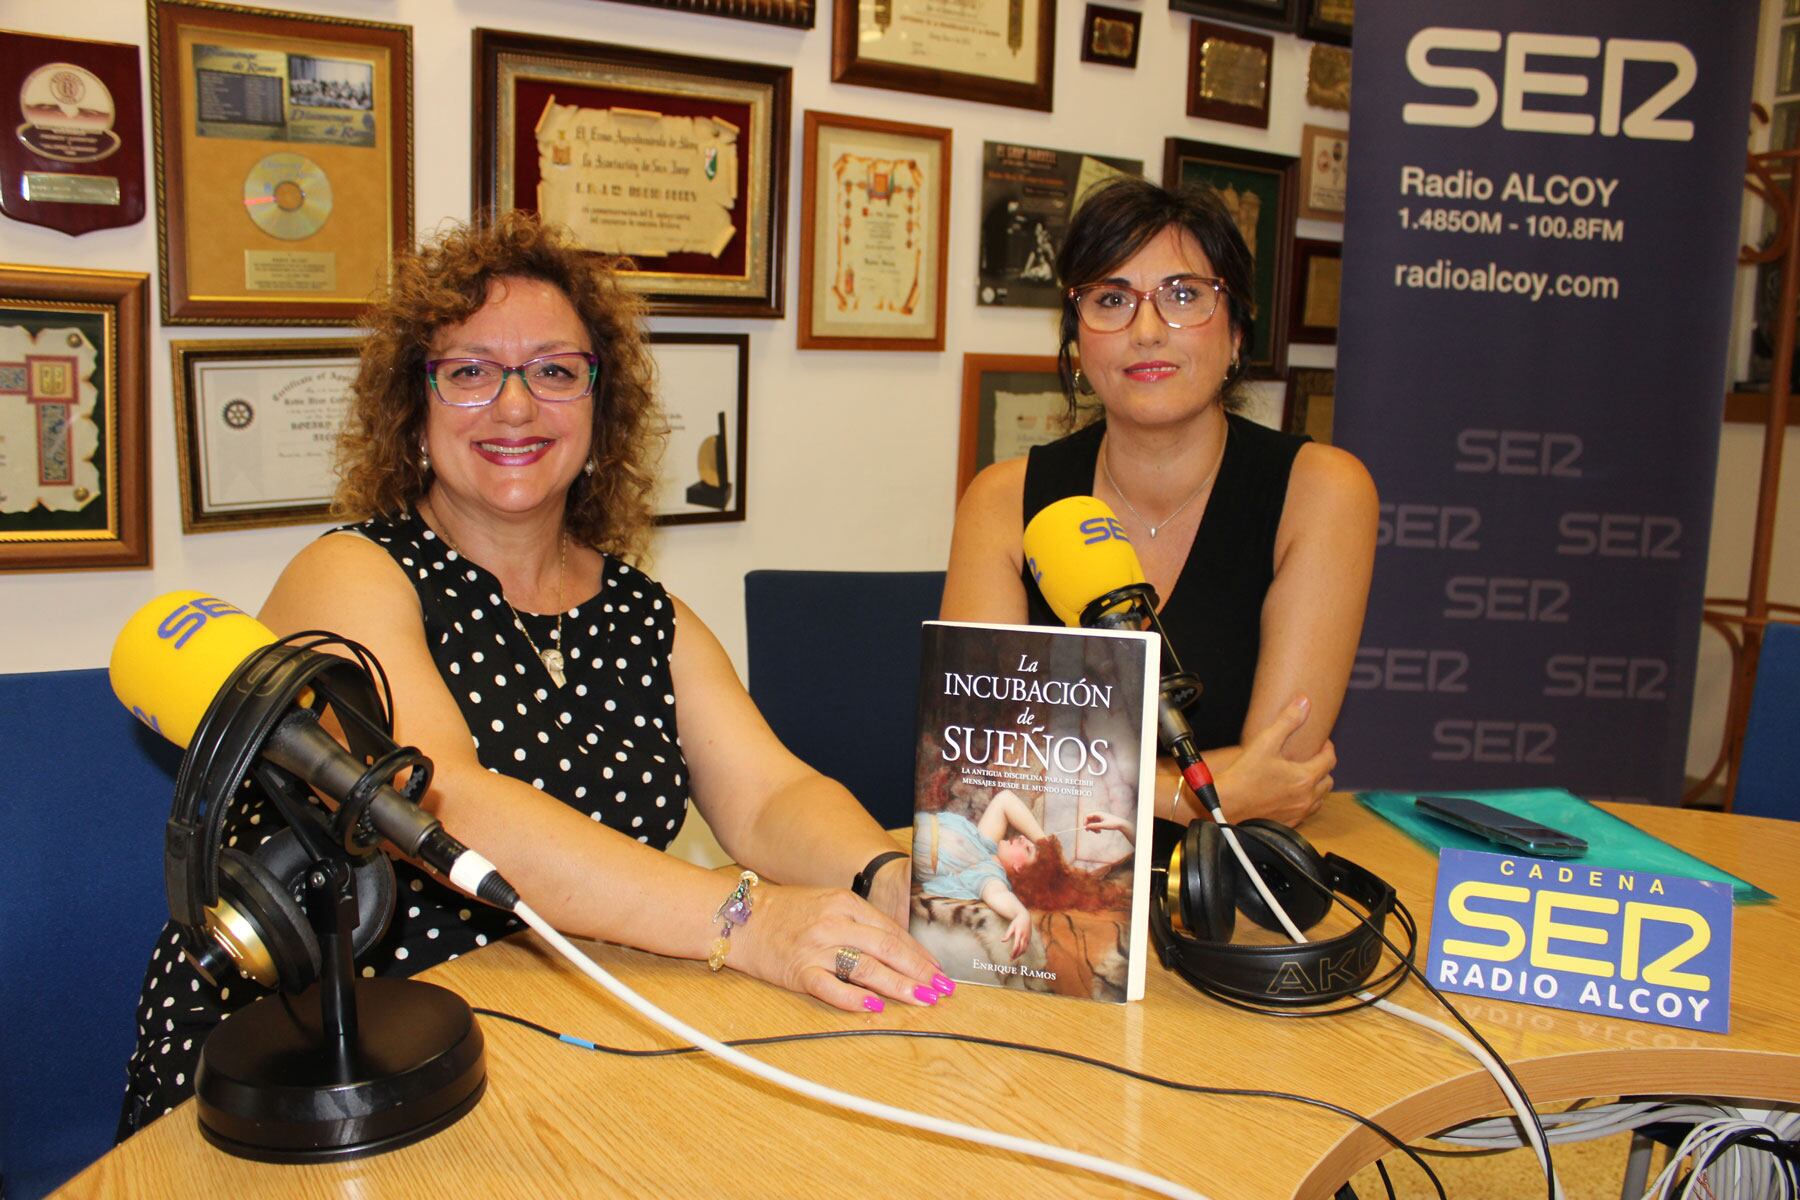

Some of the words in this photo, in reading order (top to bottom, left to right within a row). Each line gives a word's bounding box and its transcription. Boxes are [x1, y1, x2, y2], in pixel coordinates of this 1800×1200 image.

[1402, 27, 1698, 141] SER
[1401, 166, 1494, 201] Radio
[1502, 173, 1619, 208] ALCOY
[1526, 215, 1625, 242] 100.8FM
[1394, 259, 1620, 301] radioalcoy.com
[1455, 428, 1583, 478] SER
[1557, 512, 1683, 559] SER
[1443, 576, 1571, 623] SER
[1017, 654, 1039, 673] La
[1349, 647, 1469, 693] SER
[1542, 655, 1669, 700] SER
[943, 672, 1113, 709] INCUBACIÓN
[1016, 707, 1035, 726] de
[941, 725, 1109, 776] SUEÑOS
[1431, 720, 1557, 764] SER
[961, 767, 972, 775] LA
[971, 768, 1003, 778] ANTIGUA
[1004, 772, 1043, 782] DISCIPLINA
[1045, 776, 1065, 785] PARA
[1065, 778, 1094, 787] RECIBIR
[962, 777, 997, 787] MENSAJES
[997, 781, 1021, 790] DESDE
[1021, 783, 1032, 791] EL
[1031, 783, 1061, 793] MUNDO
[1500, 860, 1665, 895] CADENA
[1442, 880, 1712, 992] SER
[972, 959, 1018, 976] ENRIQUE
[1019, 965, 1057, 981] RAMOS
[1439, 959, 1559, 999] RADIO
[1579, 981, 1710, 1022] ALCOY
